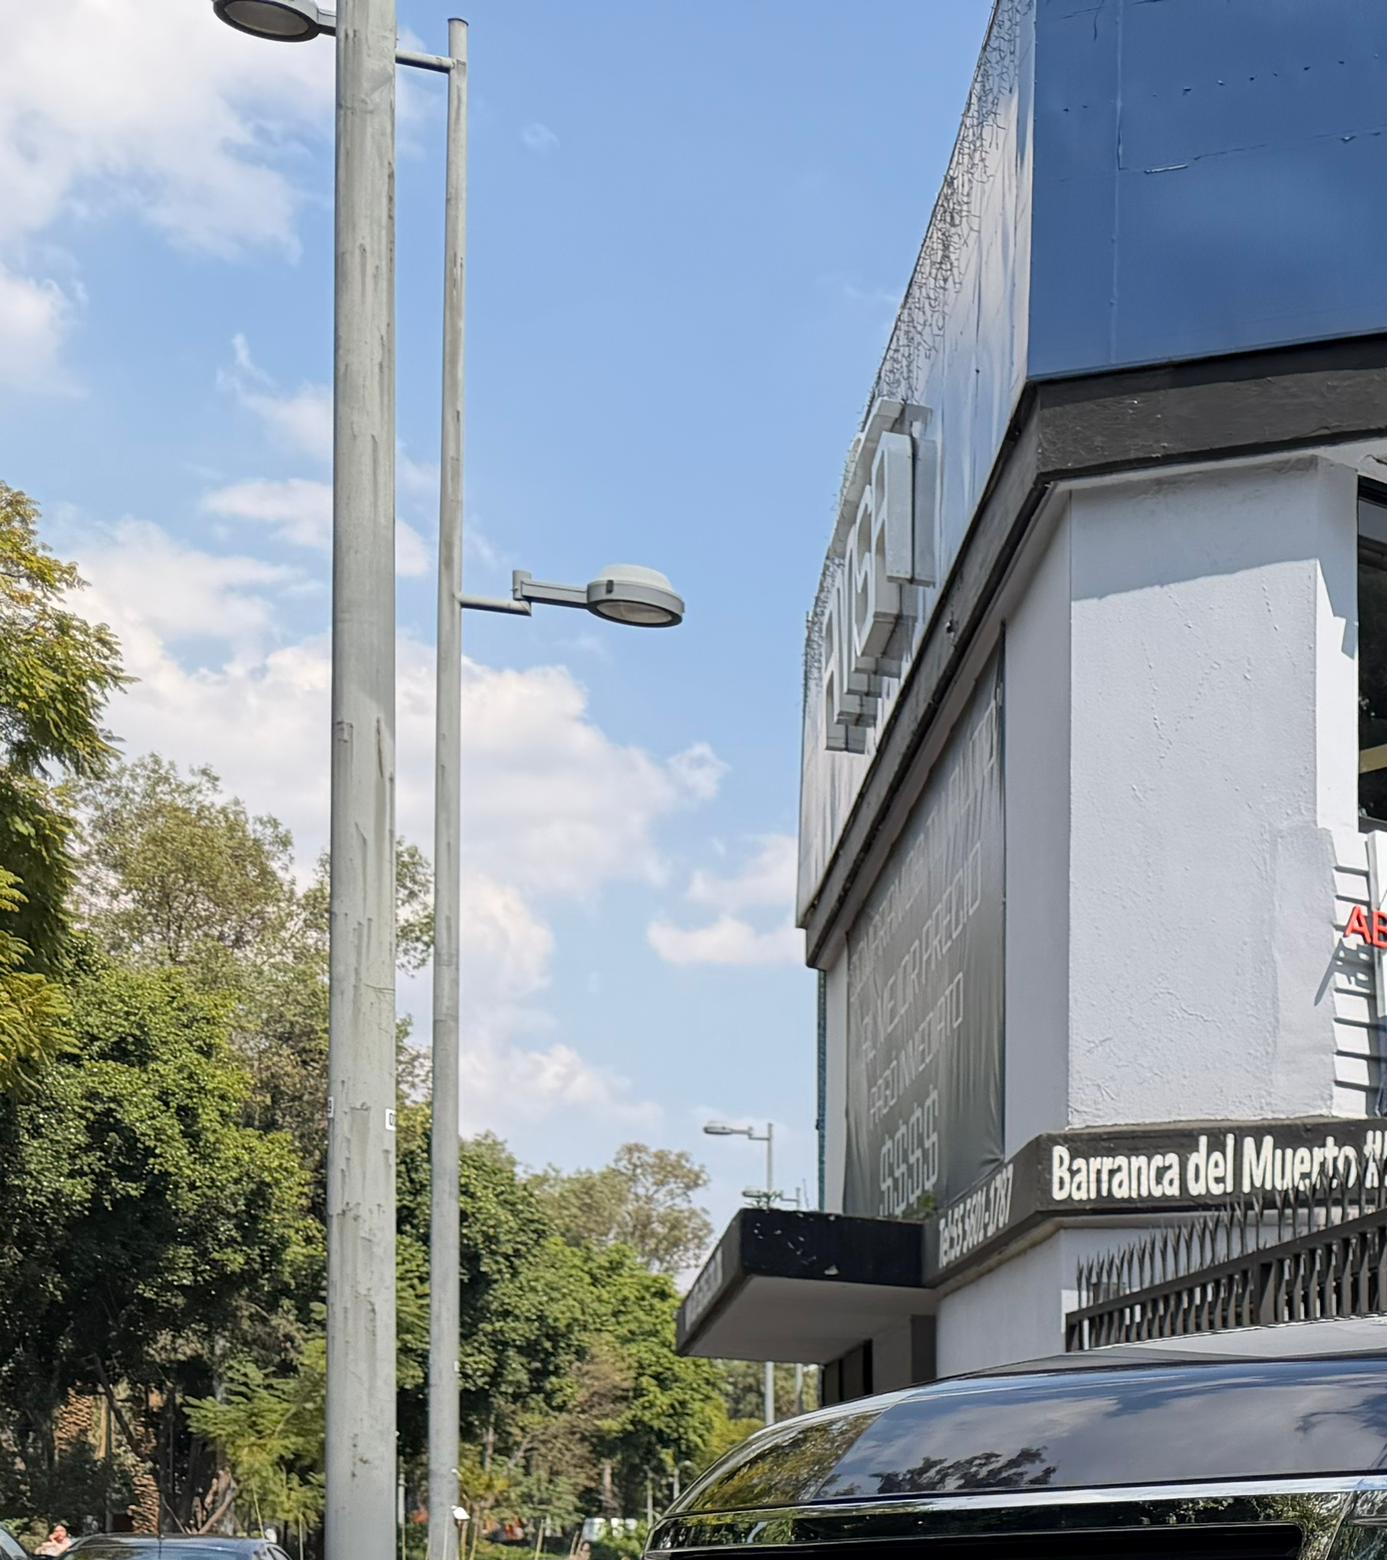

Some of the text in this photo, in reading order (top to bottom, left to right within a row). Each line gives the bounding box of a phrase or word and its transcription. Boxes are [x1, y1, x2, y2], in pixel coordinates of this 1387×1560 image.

[1052, 1145, 1180, 1201] Barranca
[1186, 1133, 1235, 1197] del
[1241, 1134, 1358, 1194] Muerto
